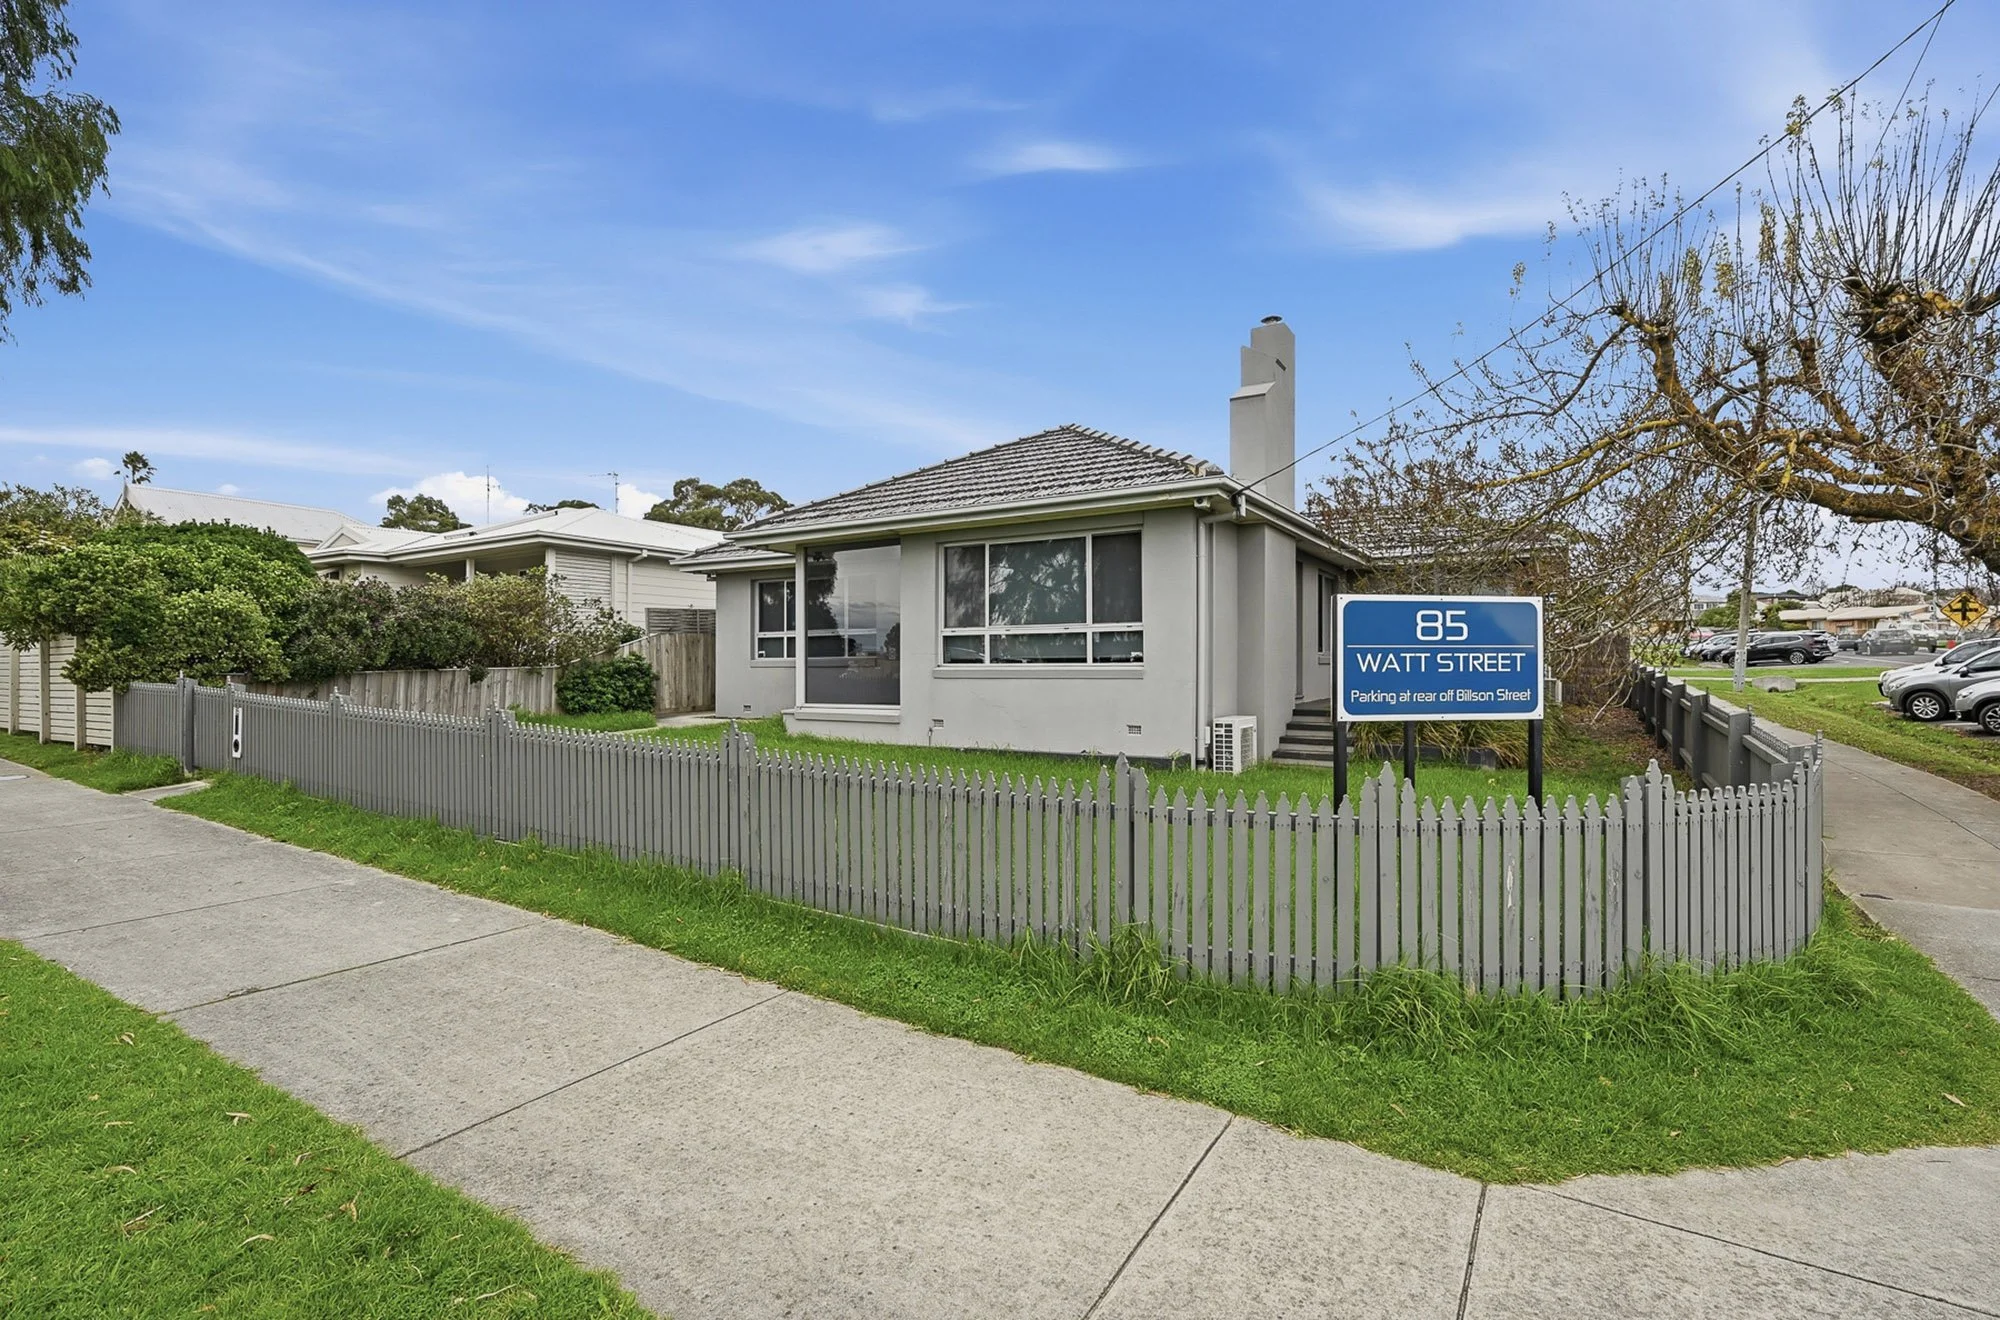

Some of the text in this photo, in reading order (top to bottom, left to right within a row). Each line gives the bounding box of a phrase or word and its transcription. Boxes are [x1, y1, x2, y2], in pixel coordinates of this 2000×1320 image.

[1416, 610, 1469, 641] 85
[1356, 653, 1526, 672] WATT STREET
[1351, 688, 1531, 705] Parking at rear off Billson Street
